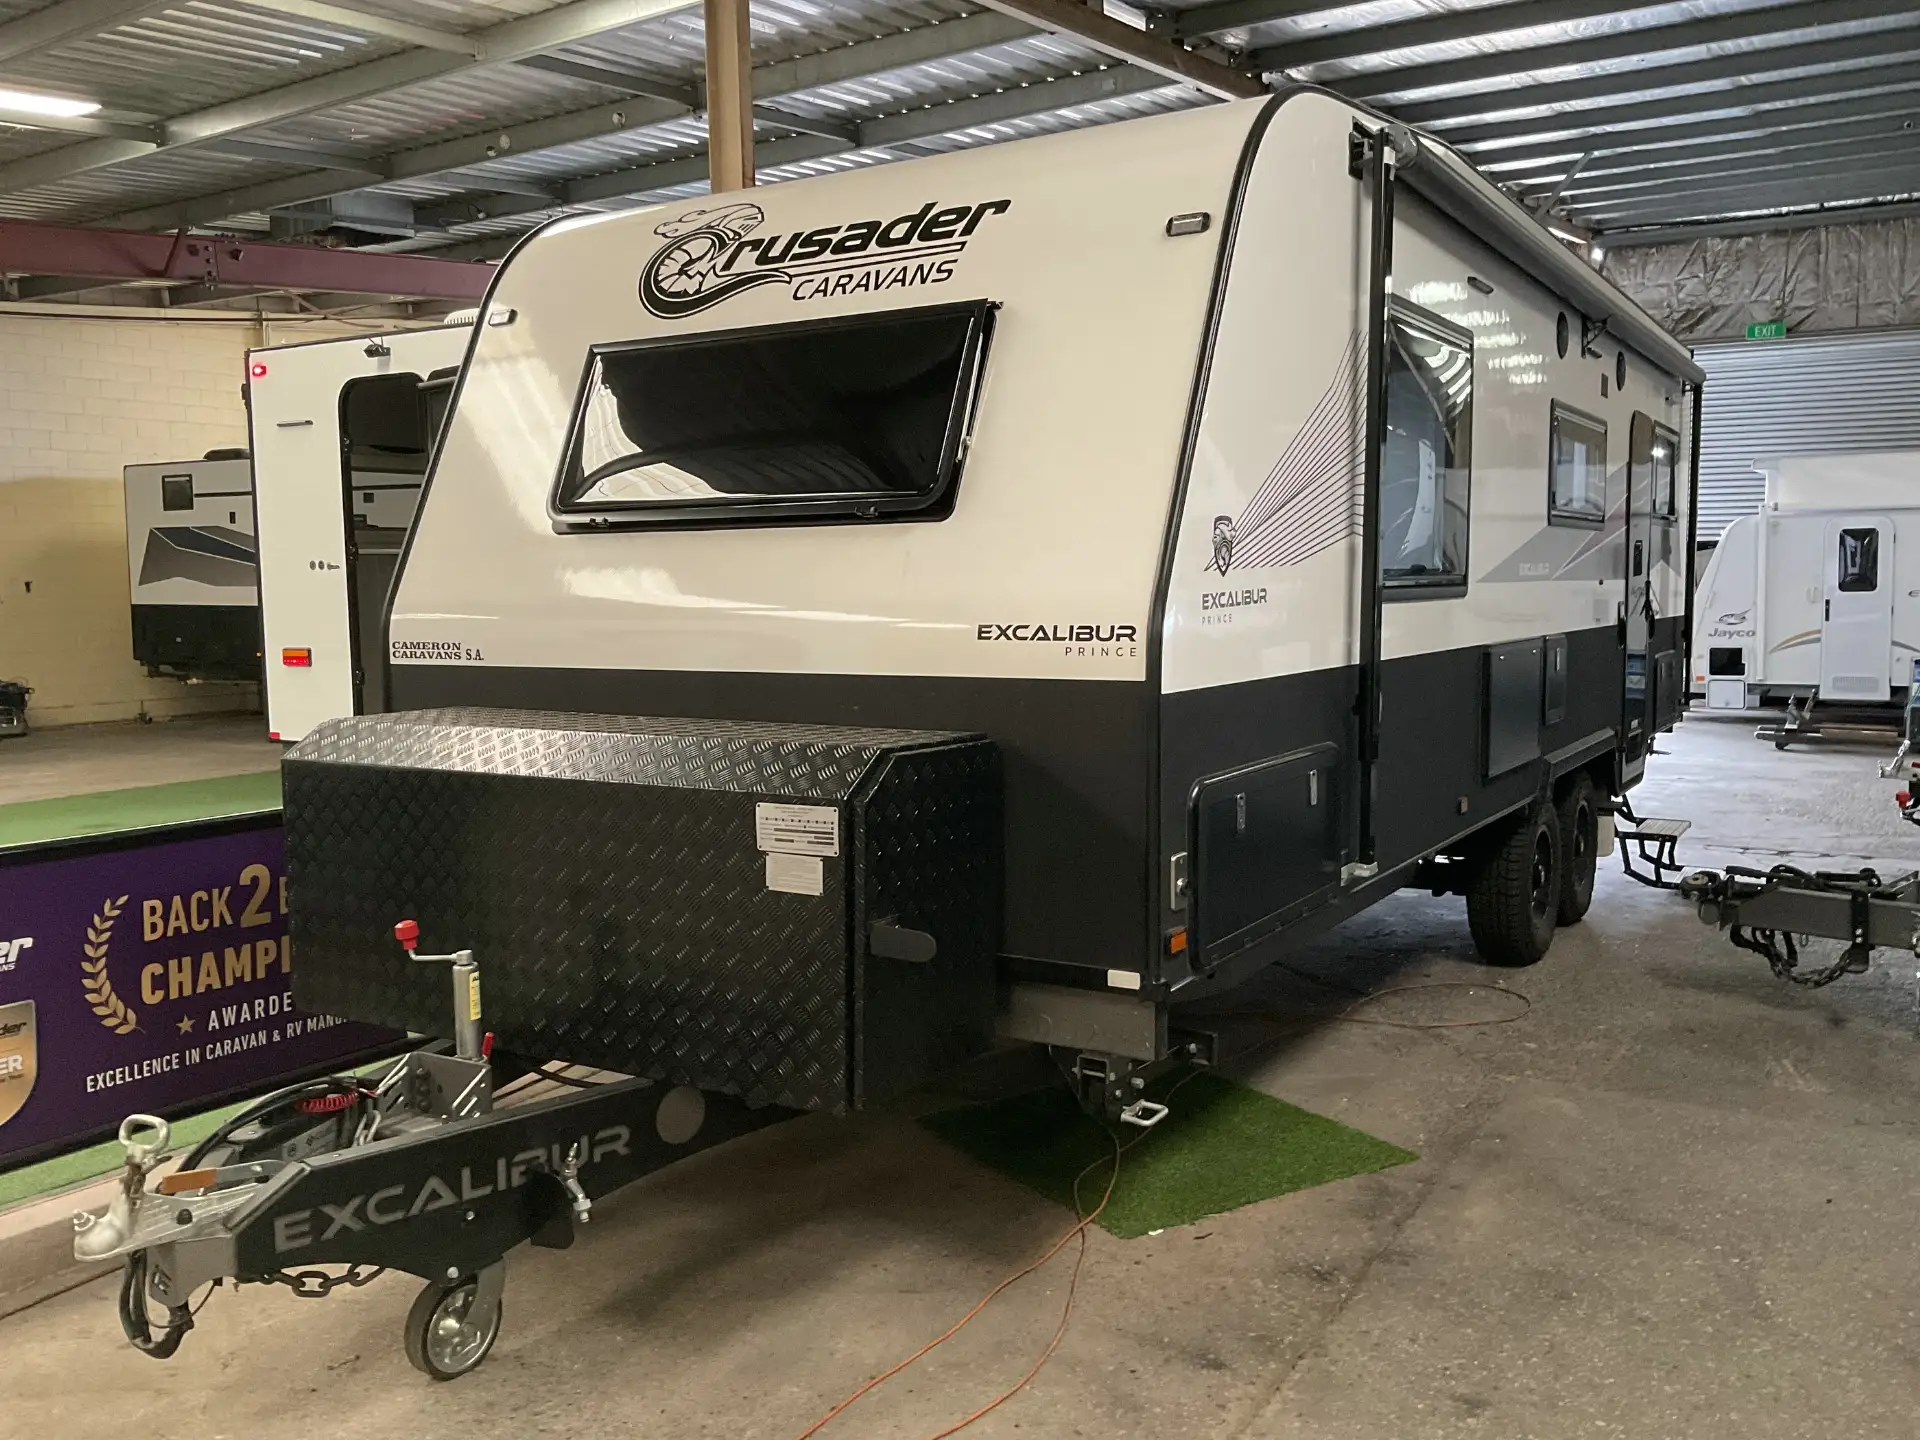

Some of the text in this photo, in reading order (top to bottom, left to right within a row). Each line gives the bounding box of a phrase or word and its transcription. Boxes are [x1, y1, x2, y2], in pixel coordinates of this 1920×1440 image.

[792, 258, 958, 301] CARAVANS
[1754, 324, 1777, 337] EXIT
[1201, 588, 1268, 610] EXCALIBUR
[1201, 613, 1233, 625] PRINCE
[976, 623, 1138, 643] EXCALIBUR
[1708, 628, 1756, 640] Jayco
[391, 641, 462, 651] CAMERON
[1065, 646, 1138, 657] PRINCE
[392, 650, 462, 660] CARAVANS
[142, 885, 233, 942] BACK
[239, 863, 272, 928] 2
[207, 991, 293, 1031] AWARDE
[86, 1052, 180, 1093] EXCELLENCE
[185, 1047, 201, 1065] IN
[206, 1033, 267, 1060] CARAVAN
[272, 1029, 281, 1042] &
[286, 1020, 302, 1038] RV
